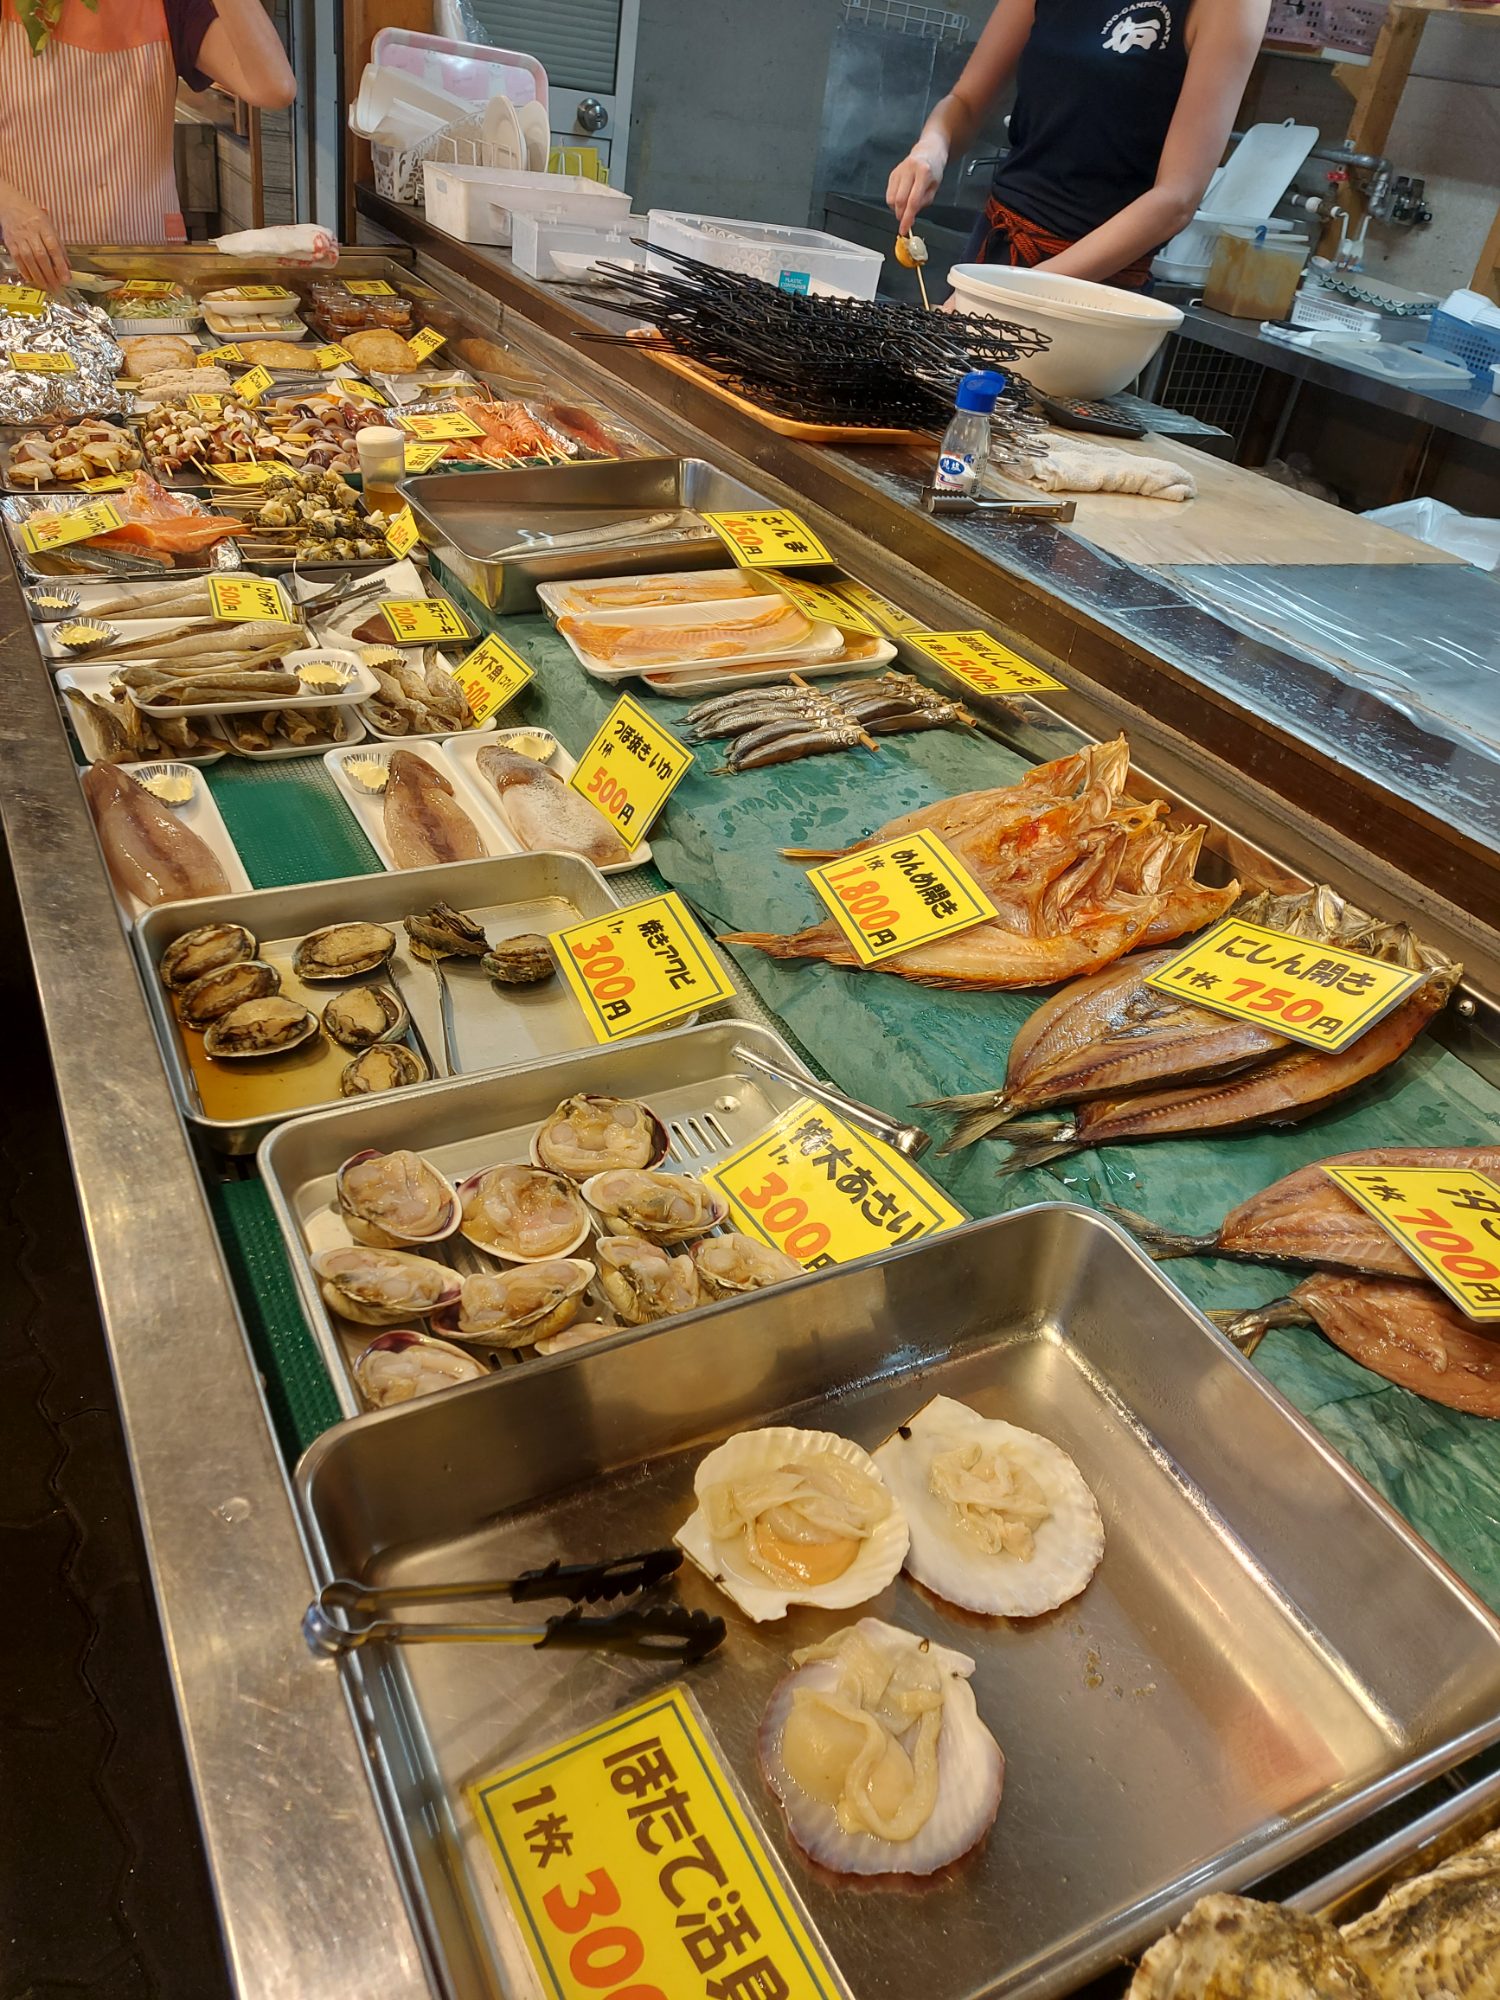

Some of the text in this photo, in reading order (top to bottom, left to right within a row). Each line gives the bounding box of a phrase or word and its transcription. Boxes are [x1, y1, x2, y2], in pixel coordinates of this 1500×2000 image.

[722, 519, 764, 555] 450円
[761, 517, 809, 553] さんま
[218, 585, 241, 611] 500円
[255, 587, 278, 616] ひめタラ
[390, 607, 417, 631] 200円
[466, 680, 491, 716] 500円
[587, 766, 635, 826] 500円
[828, 865, 899, 948] 1,800円
[890, 849, 959, 919] めんめ開き
[571, 935, 636, 1021] 300円
[637, 919, 697, 990] 焼きアワビ
[1214, 935, 1379, 997] にしん開き
[1172, 966, 1344, 1035] 1枚 750円
[789, 1117, 926, 1247] 特大あさり
[1354, 1176, 1407, 1202] 1枚
[512, 1784, 671, 2000] 1枚 30
